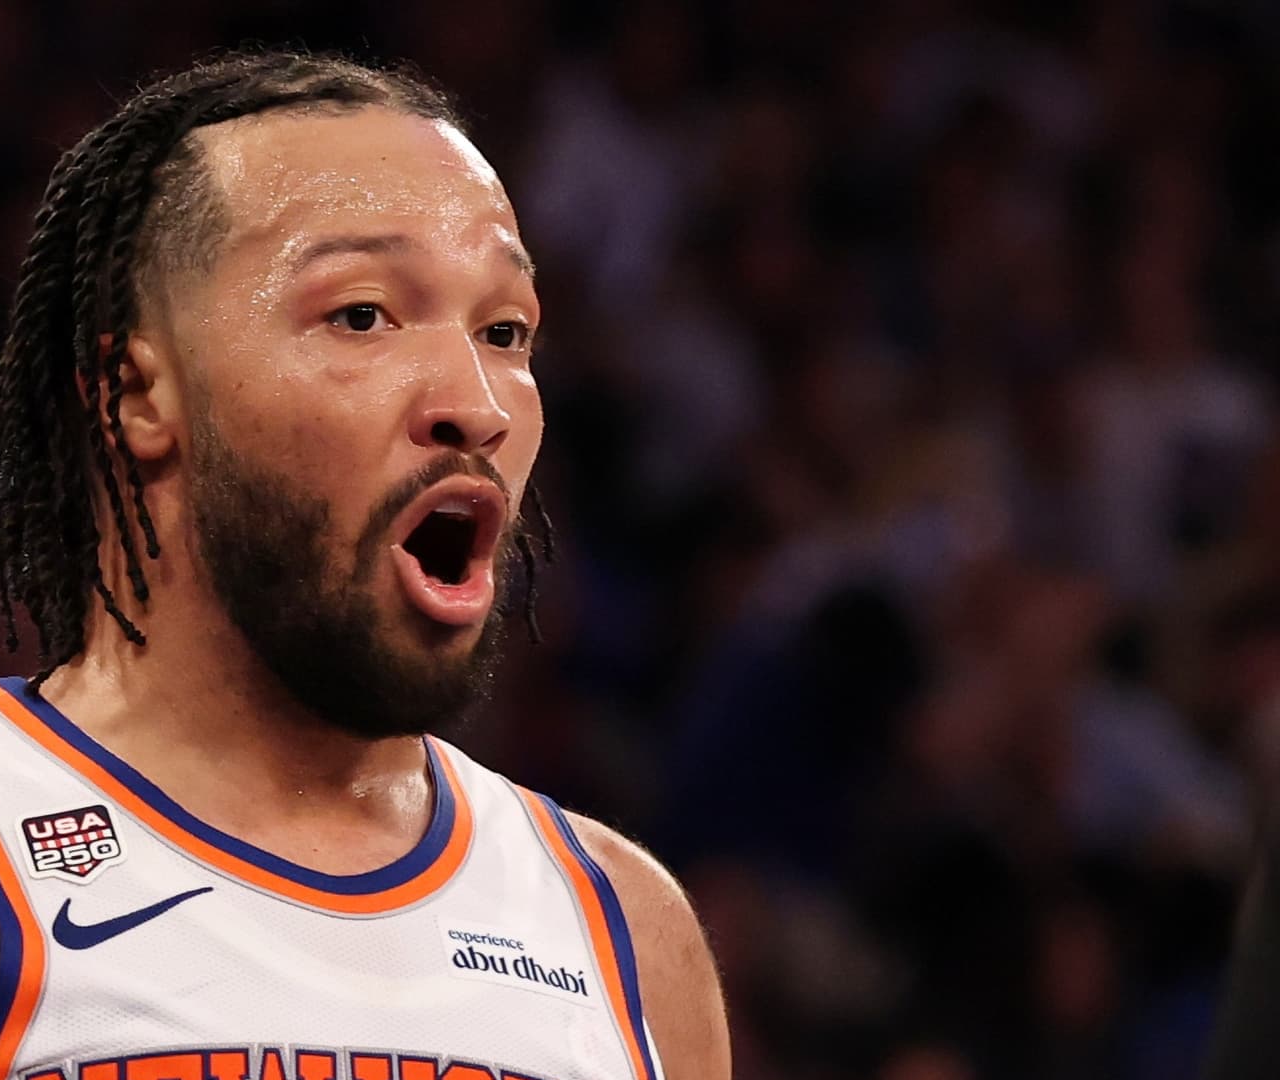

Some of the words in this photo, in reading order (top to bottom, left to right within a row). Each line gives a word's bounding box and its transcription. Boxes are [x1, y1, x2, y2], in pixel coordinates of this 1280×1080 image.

[28, 812, 106, 839] USA
[35, 839, 120, 871] 250
[448, 929, 524, 950] experience
[452, 946, 509, 975] abu
[512, 955, 588, 996] dhabi
